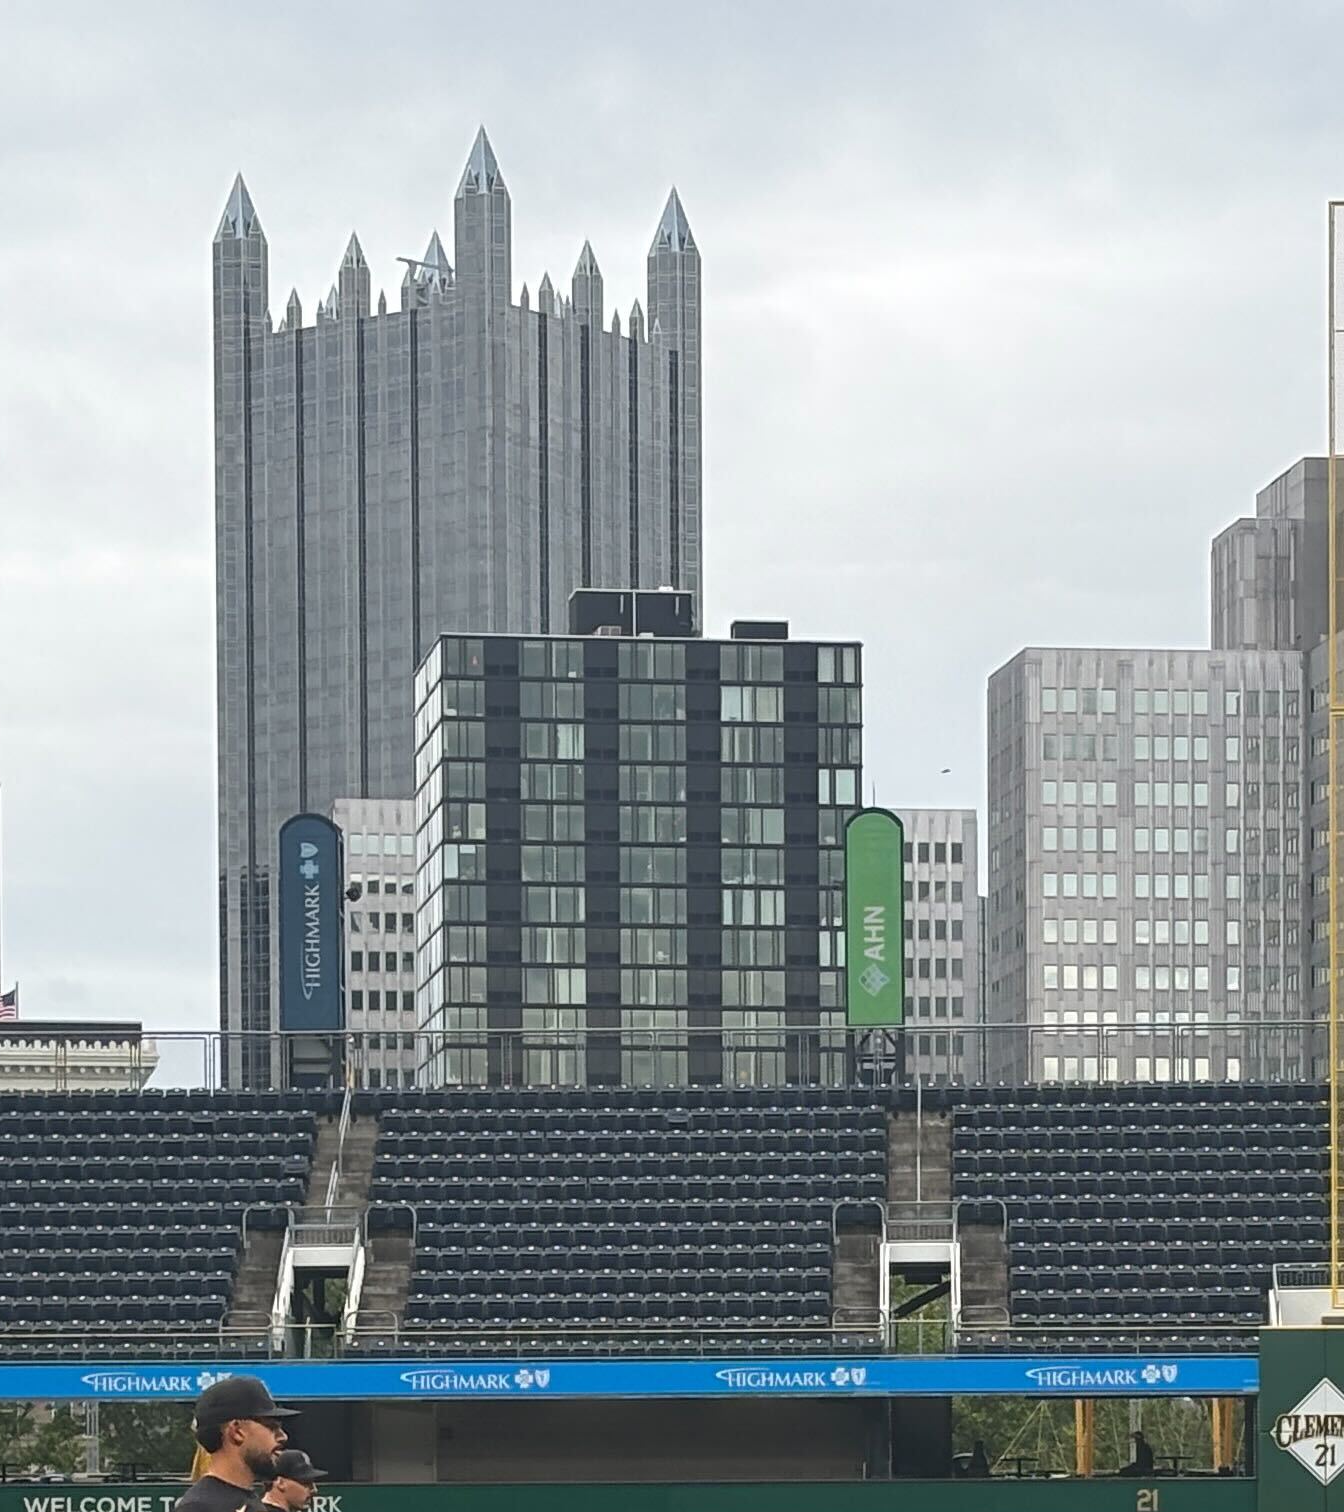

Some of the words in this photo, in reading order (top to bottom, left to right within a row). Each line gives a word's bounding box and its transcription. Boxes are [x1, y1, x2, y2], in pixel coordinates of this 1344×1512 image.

[302, 884, 320, 993] HIGHMARK
[864, 906, 886, 961] AHN
[87, 1374, 192, 1393] HIGHMARK
[405, 1371, 510, 1390] HIGHMARK
[721, 1370, 825, 1388] HIGHMARK
[1030, 1368, 1138, 1386] HIGHMARK
[1315, 1444, 1336, 1467] 21
[1136, 1489, 1159, 1512] 21
